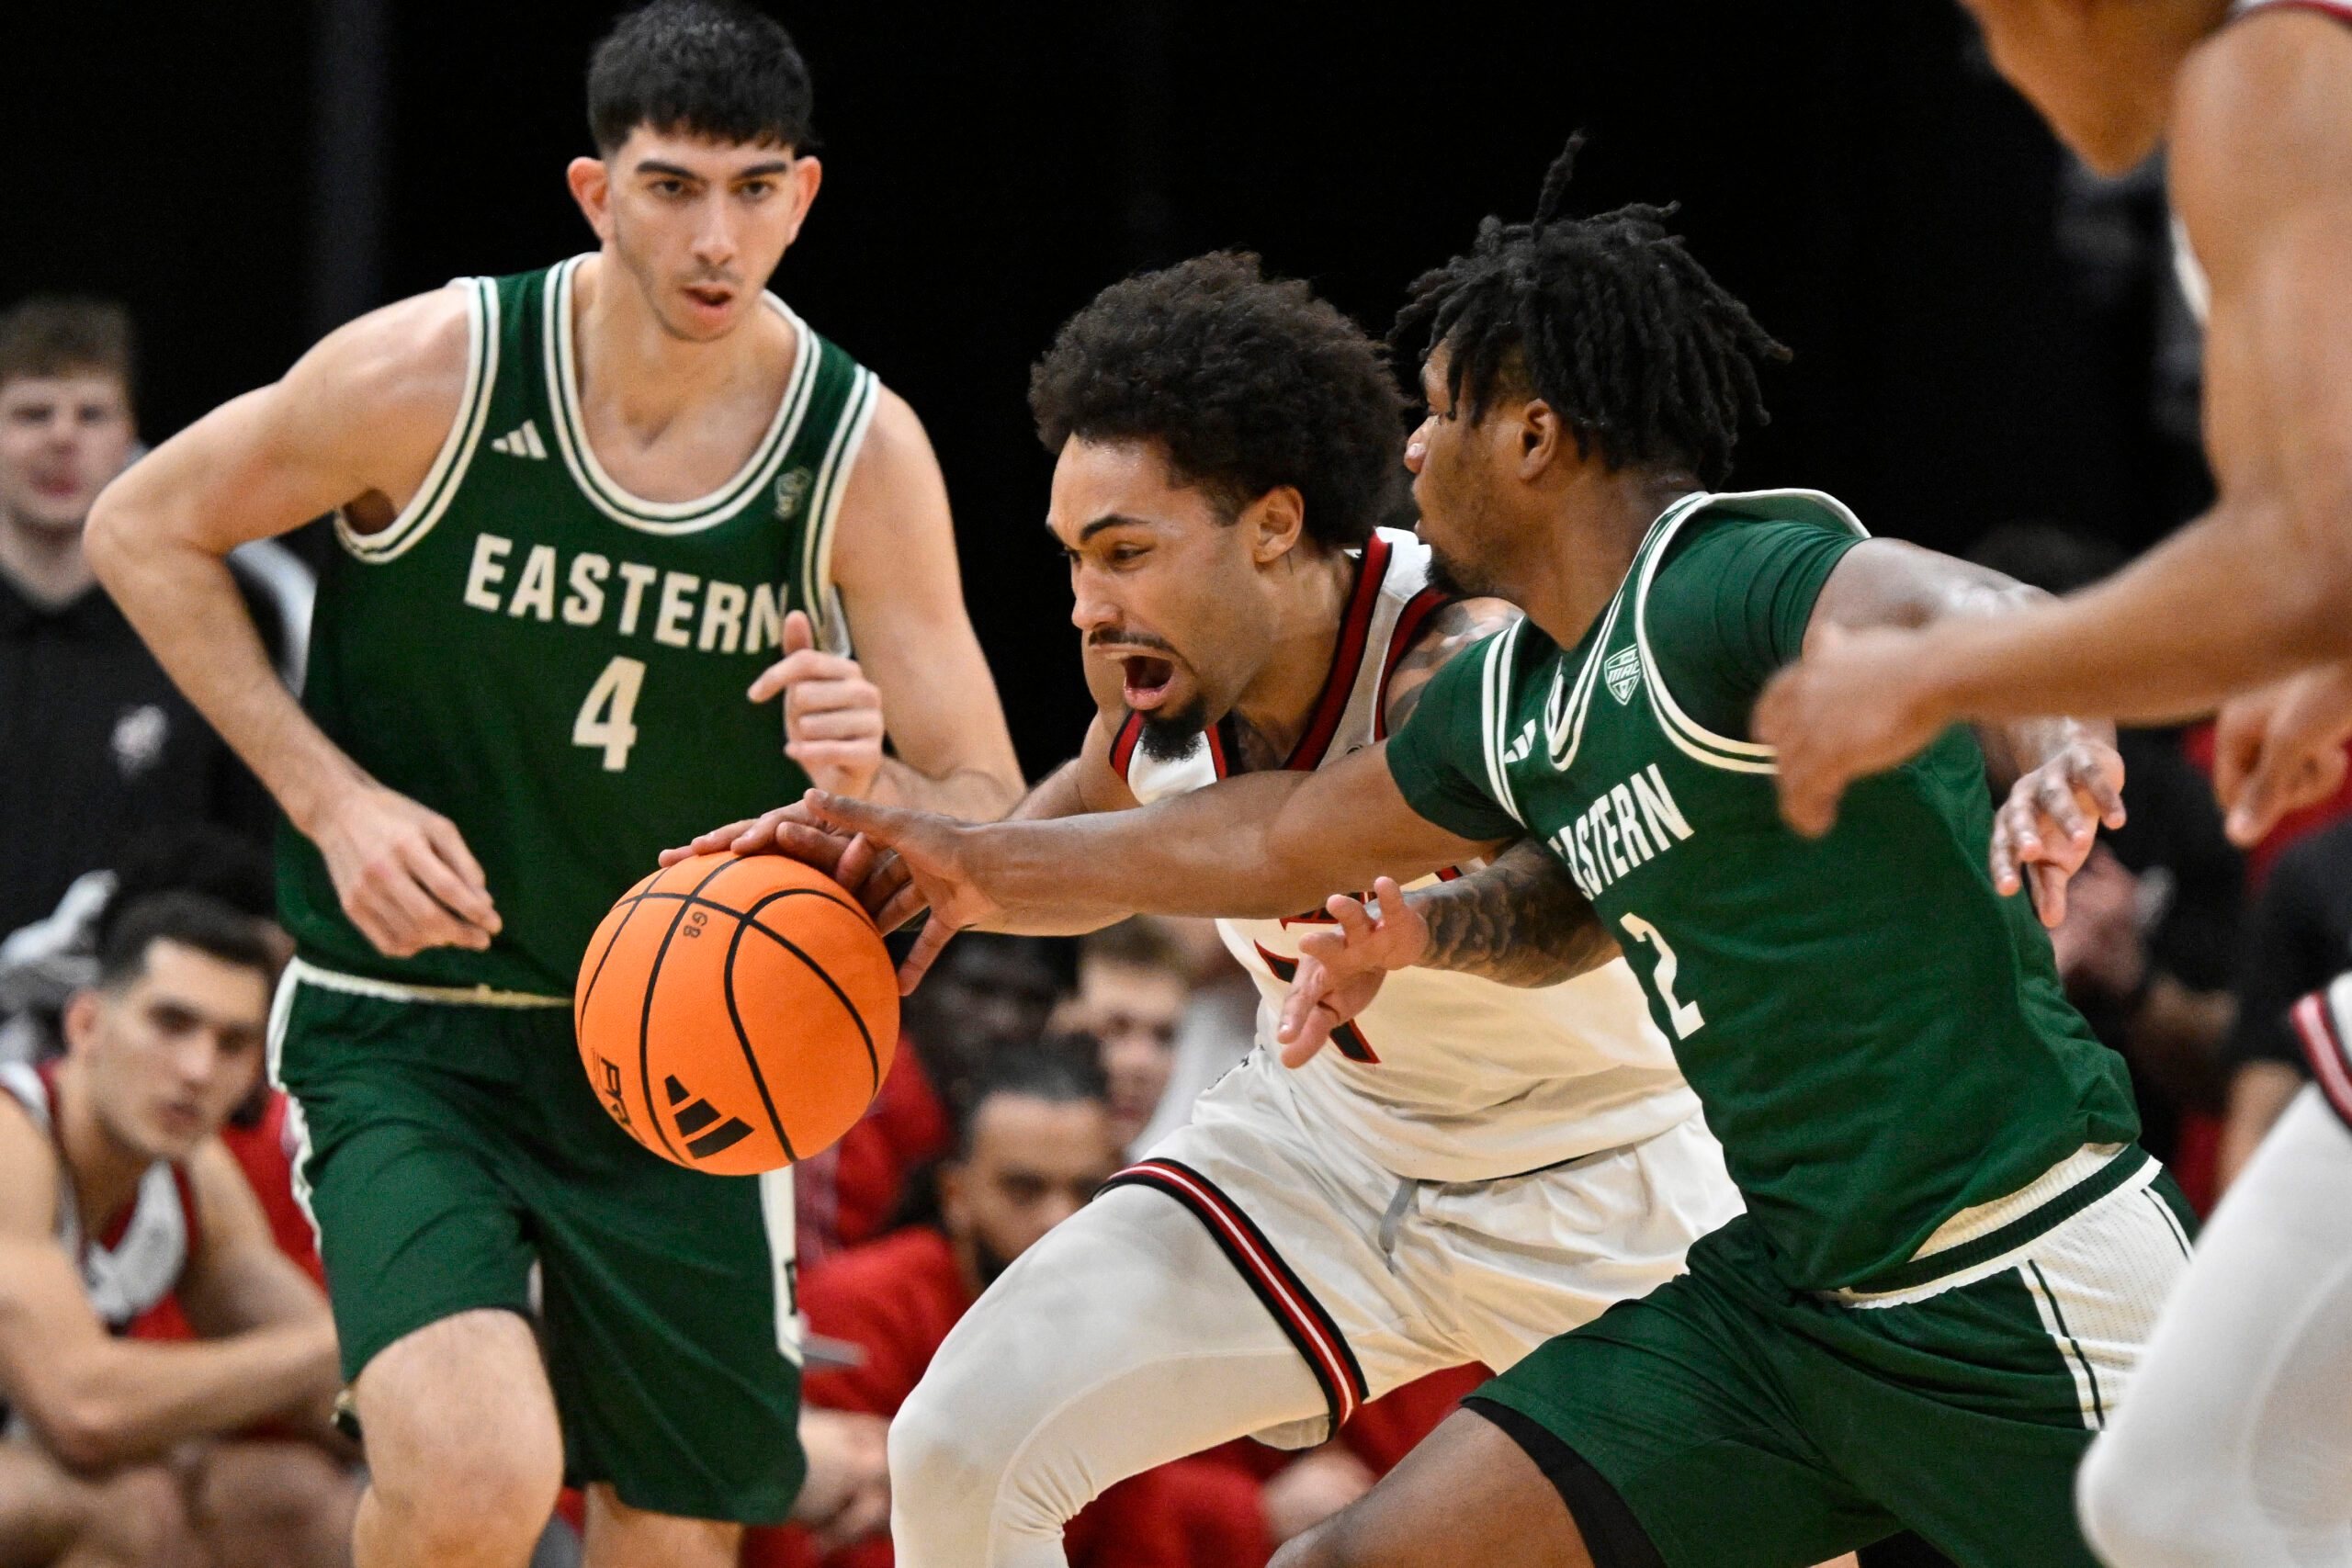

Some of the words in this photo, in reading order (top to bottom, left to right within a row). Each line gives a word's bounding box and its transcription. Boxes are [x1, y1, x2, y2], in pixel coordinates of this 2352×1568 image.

[464, 533, 788, 654] EASTERN
[571, 655, 647, 772] 4
[1607, 660, 1641, 684] MAC
[1620, 912, 1705, 1041] 2
